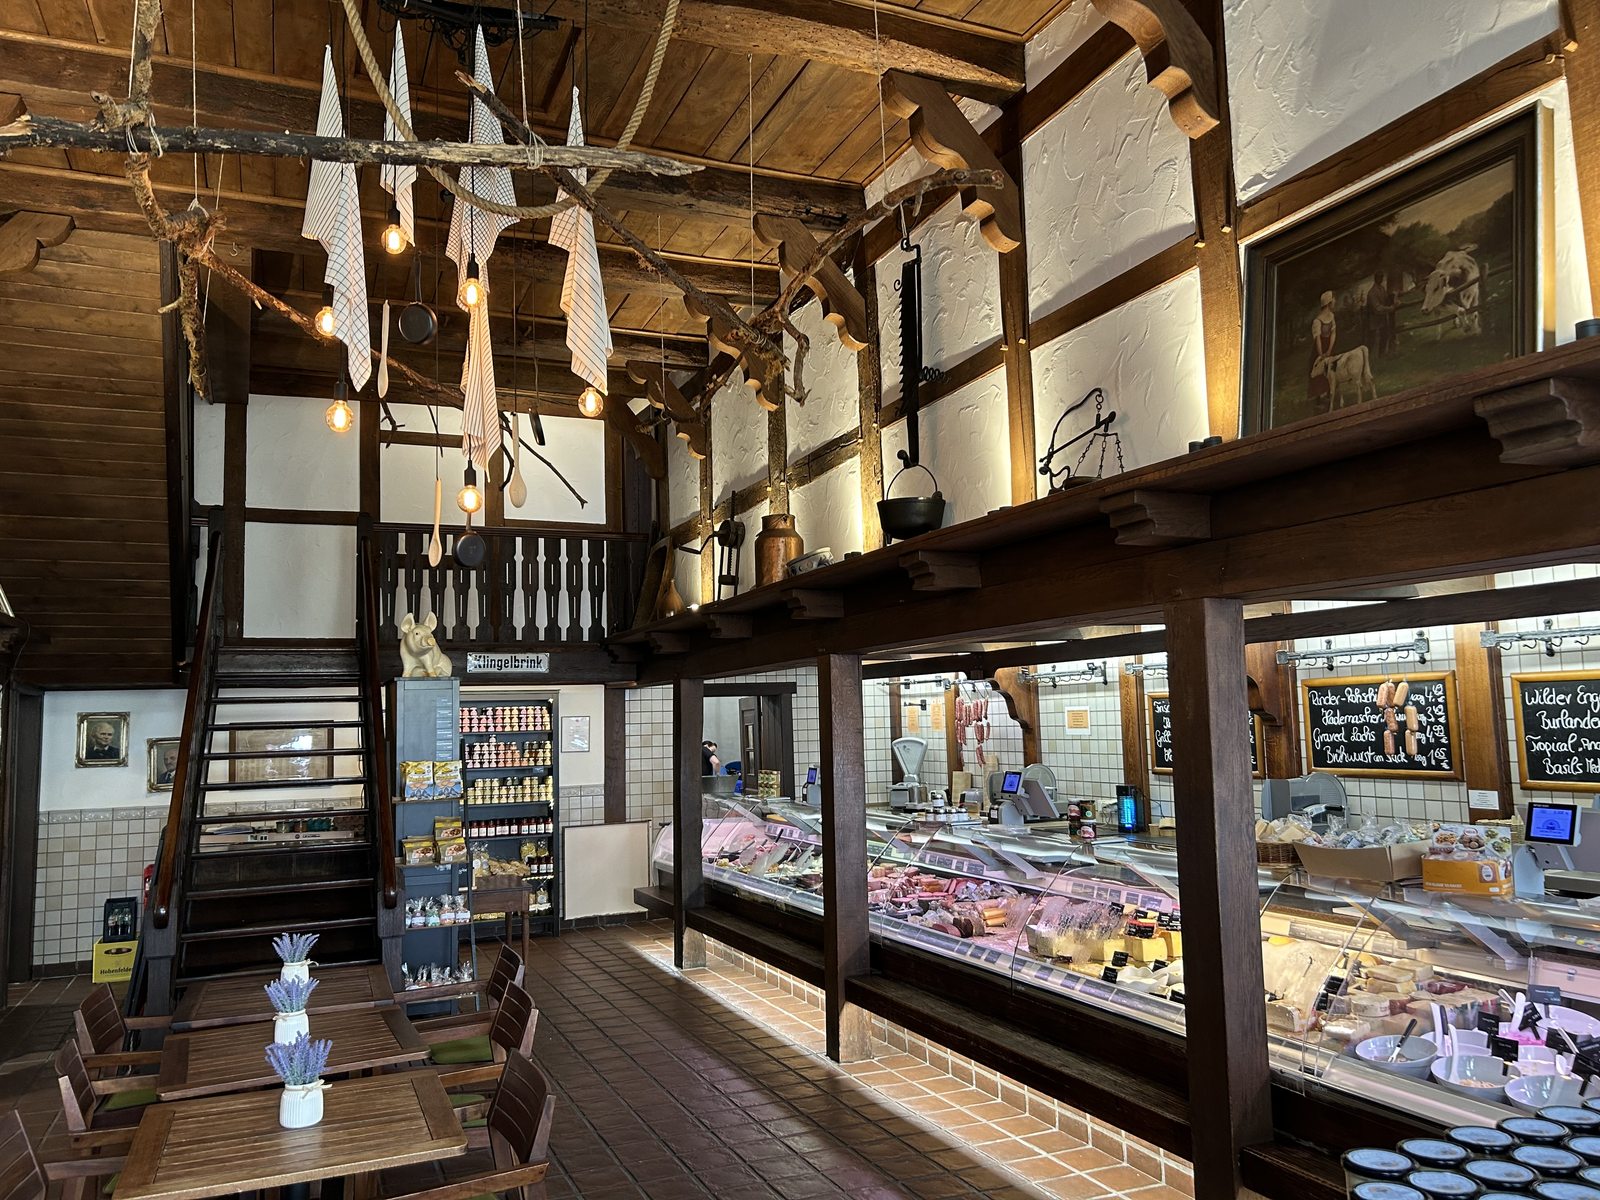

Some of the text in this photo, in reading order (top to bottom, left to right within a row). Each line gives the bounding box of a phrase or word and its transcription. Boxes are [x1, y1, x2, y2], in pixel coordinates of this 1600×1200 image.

[474, 656, 542, 671] Klingelbrink
[1525, 685, 1600, 713] Wilder Eng
[1536, 709, 1600, 730] Burlande
[1312, 726, 1348, 750] Graved
[1350, 725, 1376, 743] Lachs
[1525, 733, 1577, 758] Tropical
